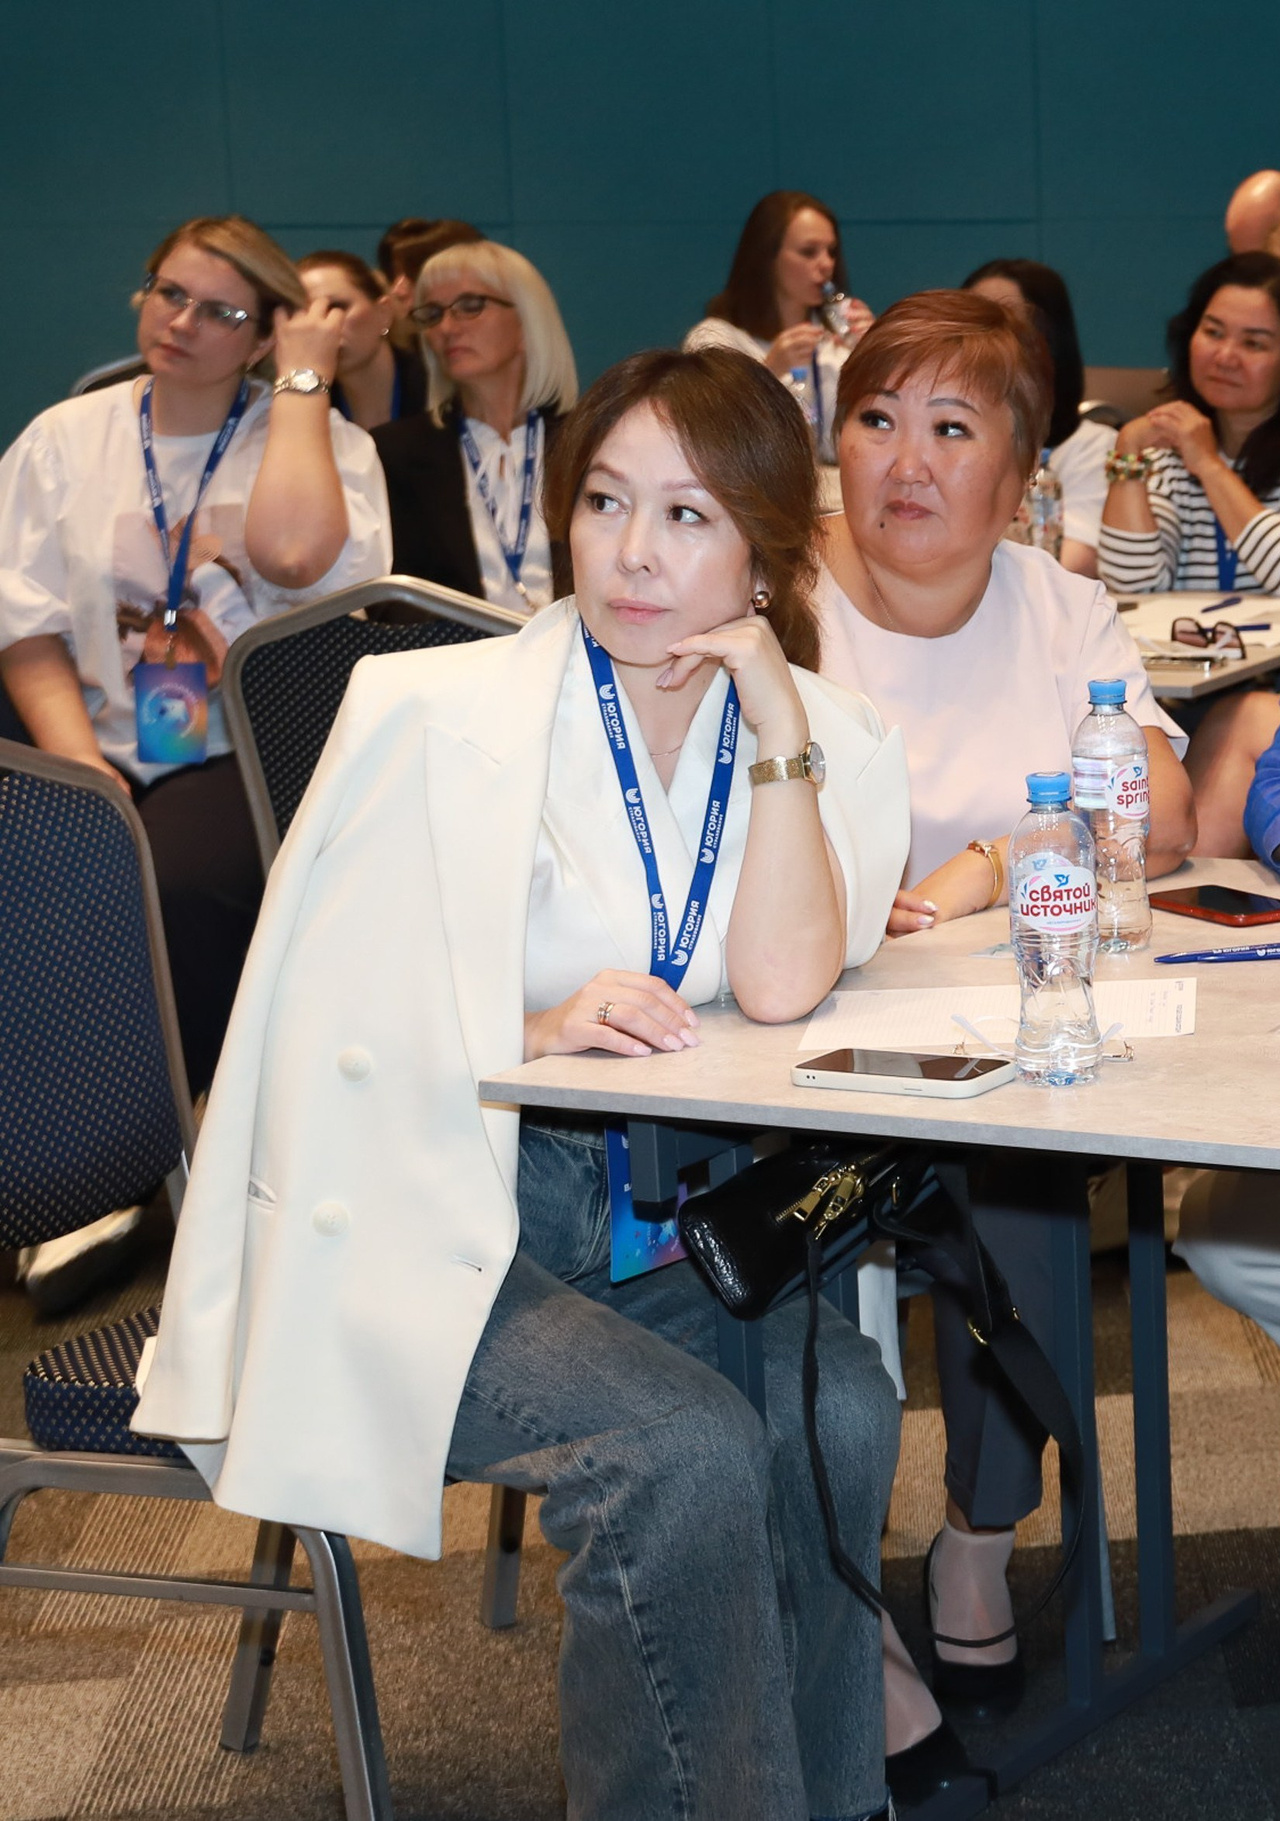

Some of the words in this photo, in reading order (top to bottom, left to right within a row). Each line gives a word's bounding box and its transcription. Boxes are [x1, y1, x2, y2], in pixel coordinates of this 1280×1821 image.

[606, 702, 626, 750] ЮГОРИЯ
[722, 703, 735, 748] ЮГОРИЯ
[632, 805, 652, 854] ЮГОРИЯ
[705, 800, 721, 847] ЮГОРИЯ
[656, 911, 666, 962] ЮГОРИЯ
[679, 900, 700, 948] ЮГОРИЯ
